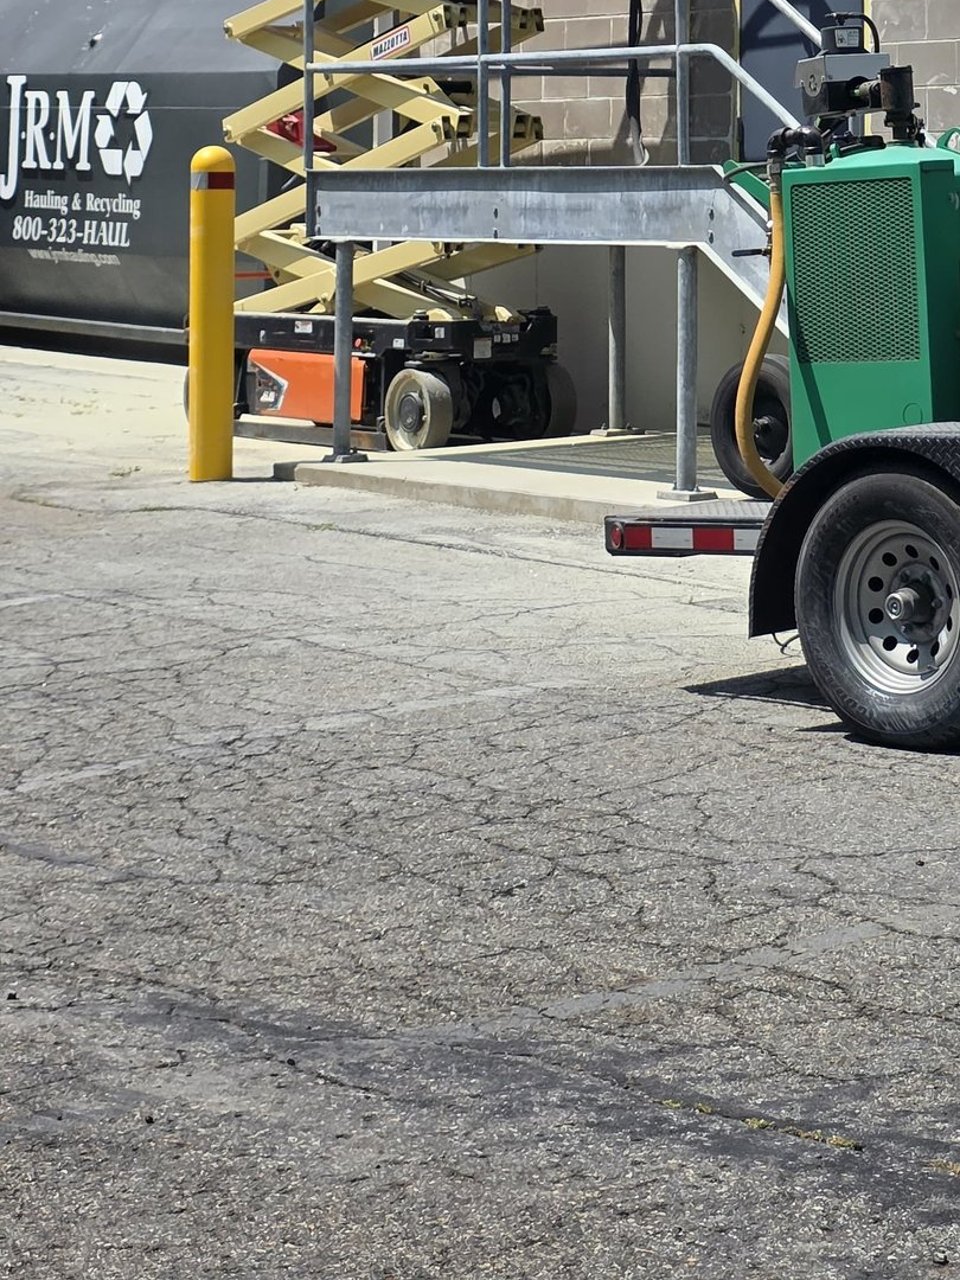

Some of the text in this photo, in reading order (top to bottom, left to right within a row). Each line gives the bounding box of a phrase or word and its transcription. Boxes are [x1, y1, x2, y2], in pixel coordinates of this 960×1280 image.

[373, 31, 407, 57] MAZZOTTA
[24, 190, 141, 219] Hauling & Recycling
[12, 216, 130, 247] 800-323-HAUL
